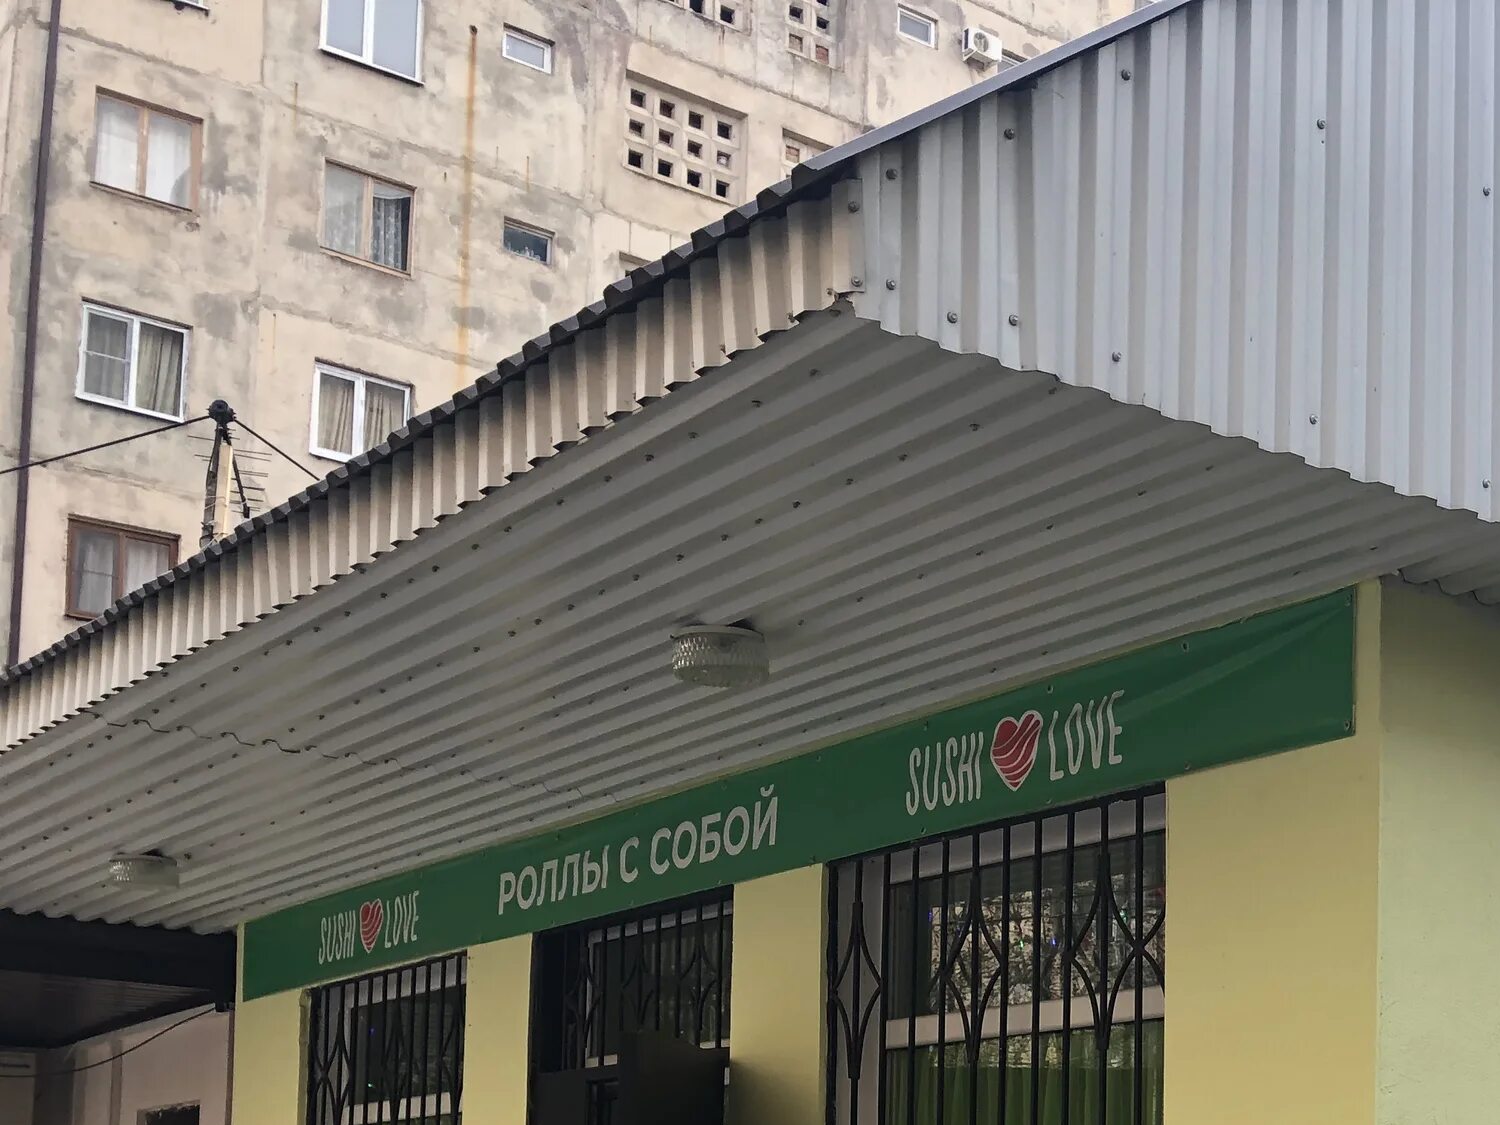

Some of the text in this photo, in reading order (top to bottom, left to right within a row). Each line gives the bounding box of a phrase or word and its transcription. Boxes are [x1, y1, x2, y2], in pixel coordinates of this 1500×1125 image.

[905, 689, 1125, 816] SUSHI LOVE
[498, 784, 779, 916] РОЛЛЫ С СОБОЙ
[318, 890, 420, 965] SUSHI LOVE
